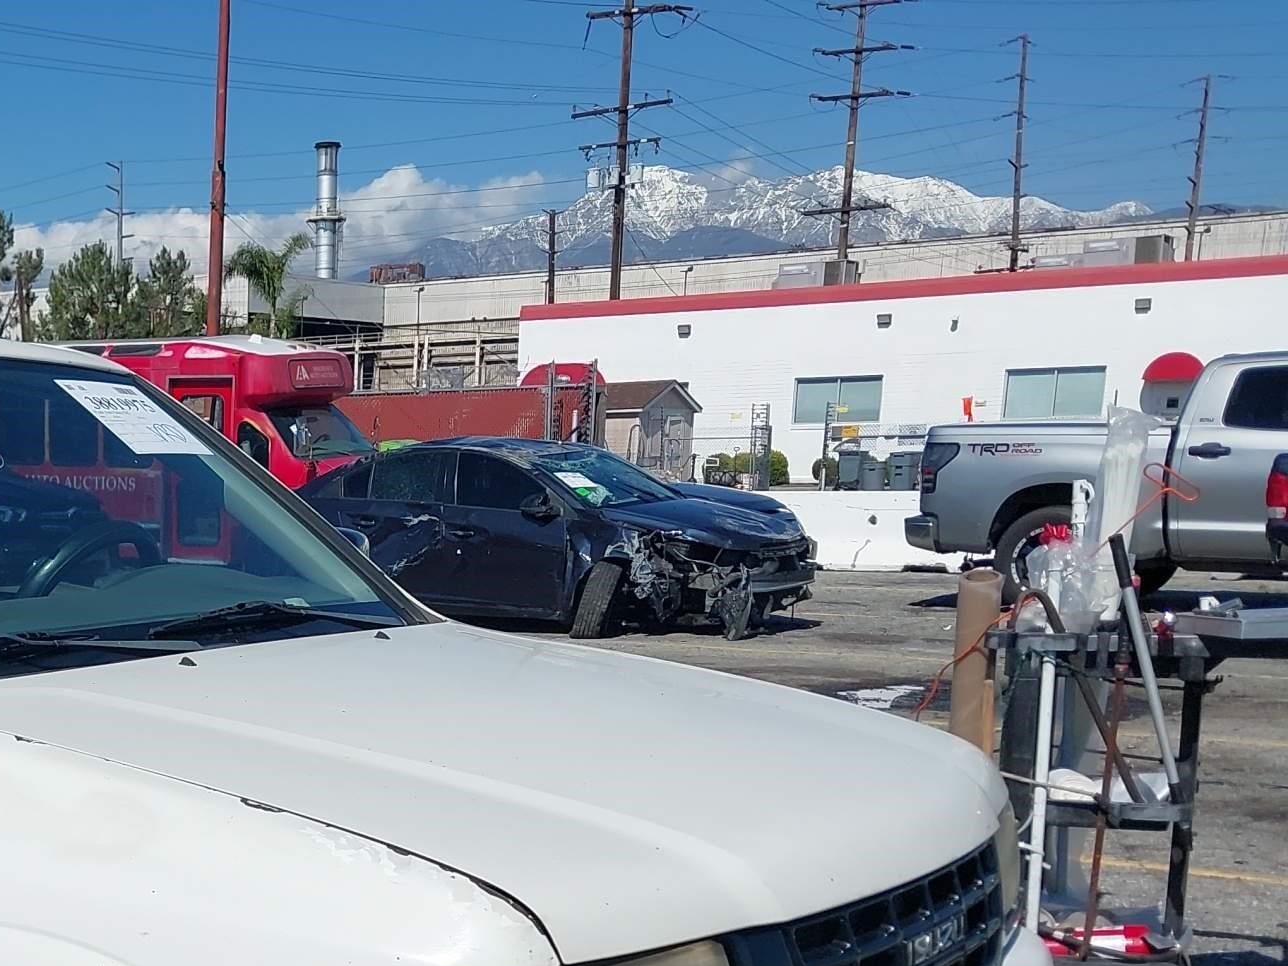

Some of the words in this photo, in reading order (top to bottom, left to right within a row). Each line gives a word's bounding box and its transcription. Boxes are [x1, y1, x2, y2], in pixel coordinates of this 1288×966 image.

[83, 396, 156, 413] 38819975
[968, 443, 1010, 456] TRD
[64, 475, 136, 491] AUCTIONS
